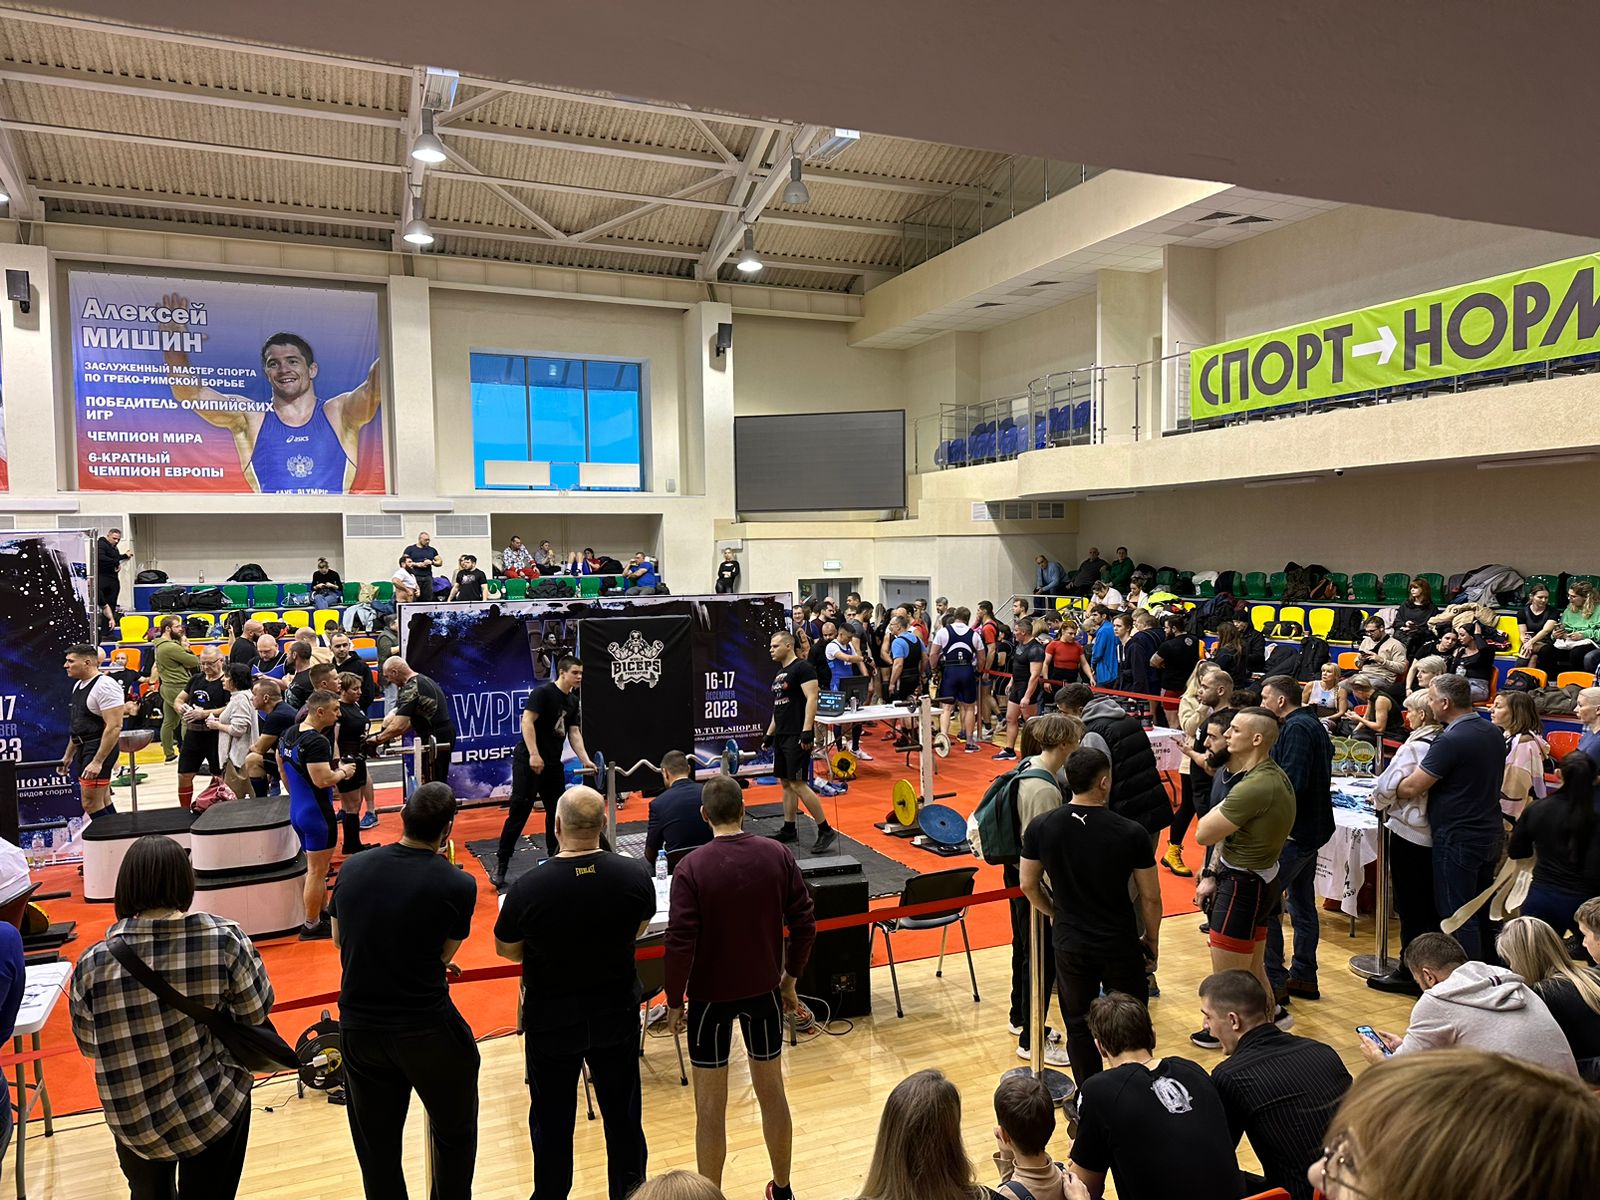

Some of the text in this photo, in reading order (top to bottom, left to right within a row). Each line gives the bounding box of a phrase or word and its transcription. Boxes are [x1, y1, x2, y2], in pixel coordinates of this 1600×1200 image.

[82, 298, 208, 326] Алексей
[82, 326, 203, 353] МИШИН
[85, 361, 257, 377] ЗАСЛУЖЕННЫЙ МАСТЕР СПОРТА
[1200, 322, 1353, 406] СПОРТ
[85, 374, 246, 388] ПО ГРЕКО-РИМСКОЙ БОРЬБЕ
[85, 396, 275, 413] ПОБЕДИТЕЛЬ ОЛИПИЙСКИХ
[86, 410, 114, 421] ИГР
[87, 431, 203, 444] ЧЕМПИОН МИРА
[88, 451, 171, 464] 6-КРАТНЫЙ
[88, 466, 224, 478] ЧЕМПИОН ЕВРОПЫ
[612, 660, 660, 675] BICEPS
[704, 671, 736, 690] 16-17
[705, 690, 736, 701] DECEMBER
[704, 700, 738, 719] 2023
[45, 787, 73, 796] спорта
